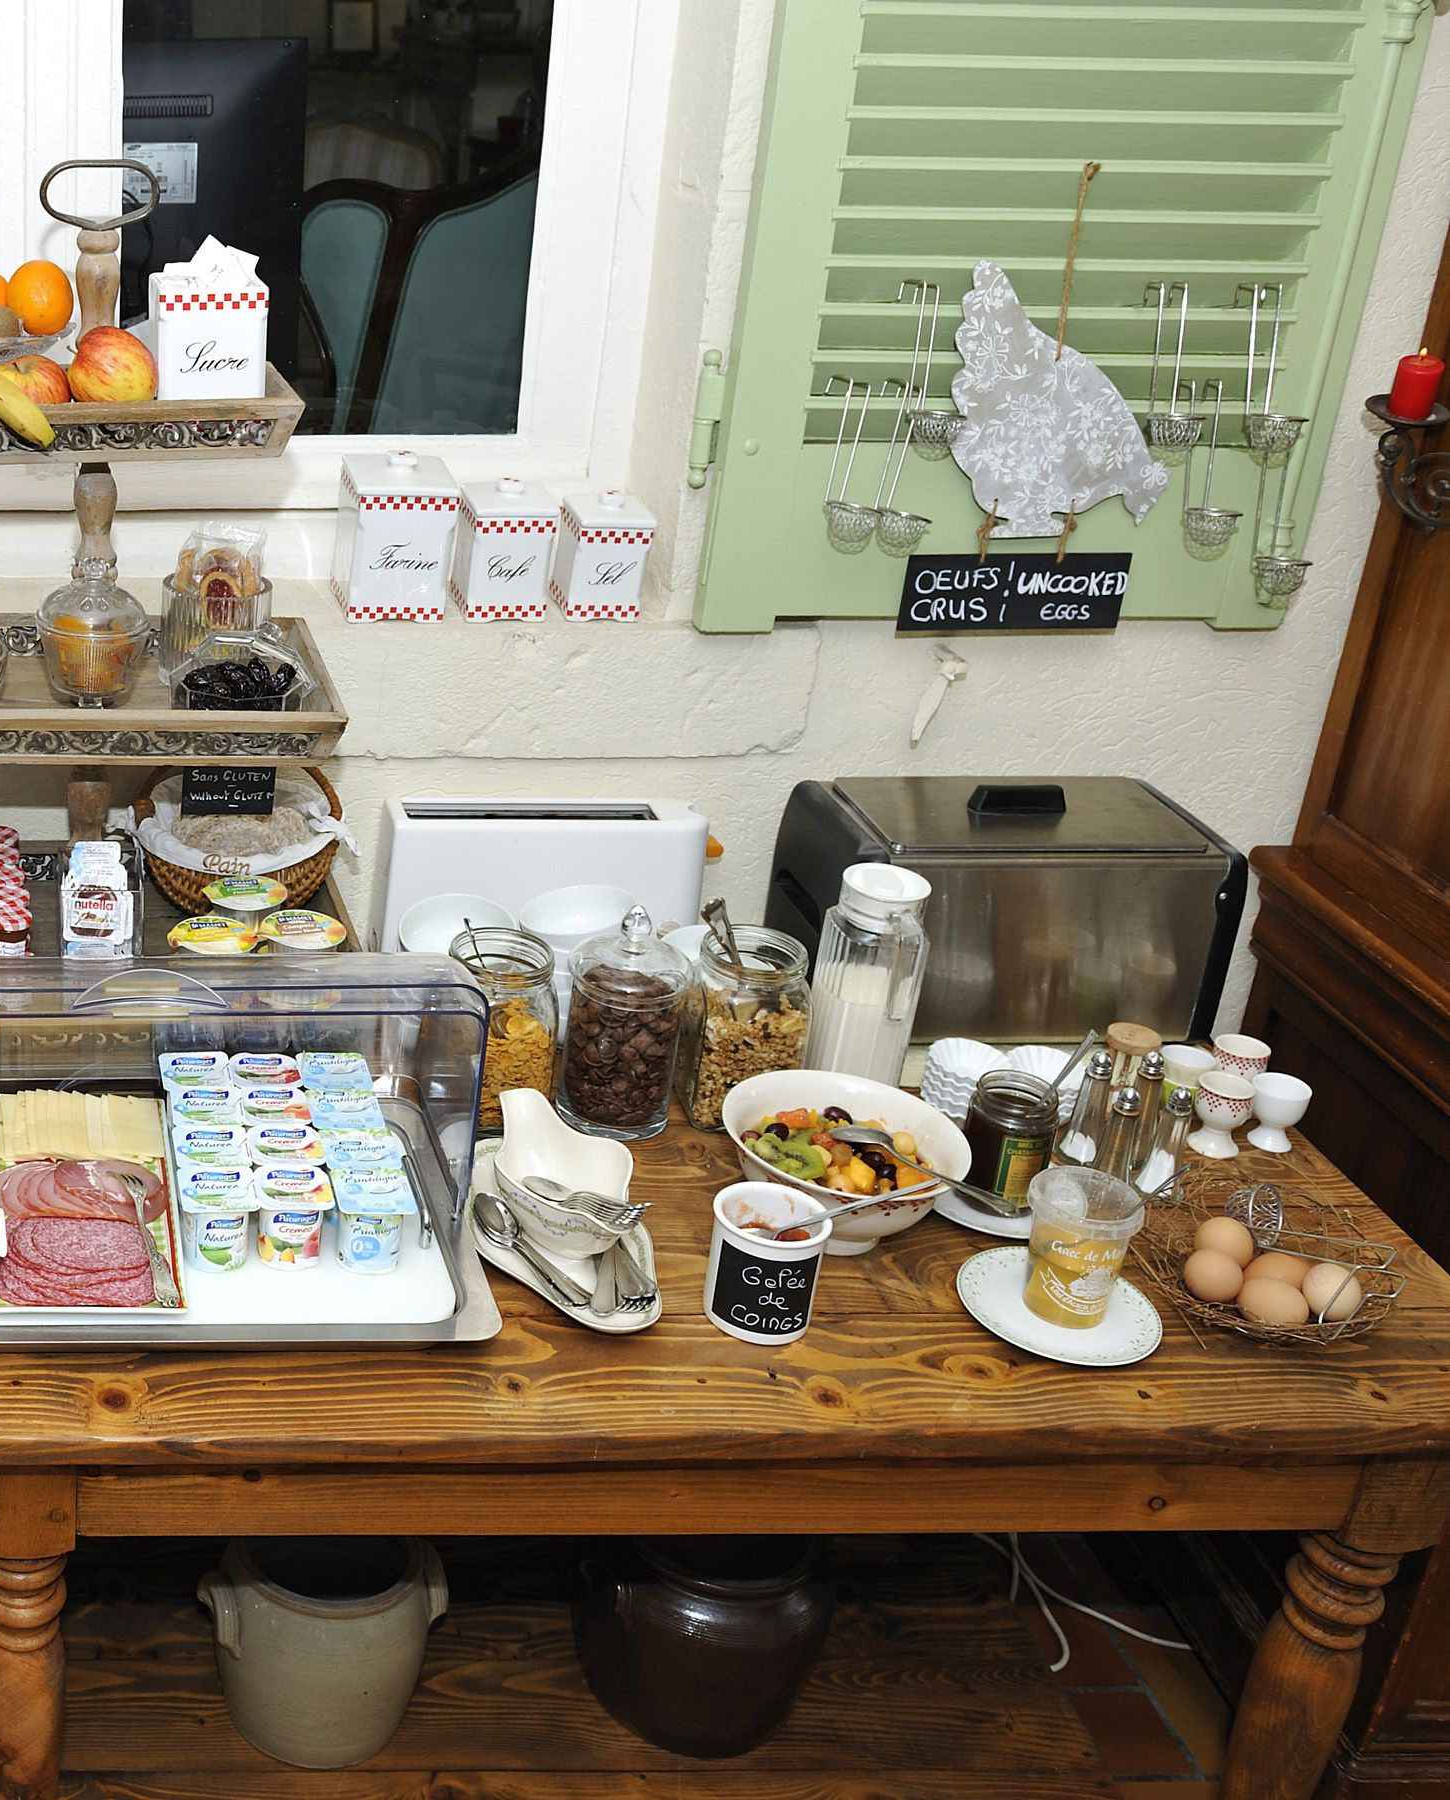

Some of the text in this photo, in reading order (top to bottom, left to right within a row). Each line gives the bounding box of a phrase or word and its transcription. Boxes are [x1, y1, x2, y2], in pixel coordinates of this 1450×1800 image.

[179, 340, 249, 374] Sucre
[369, 542, 439, 571] Farine
[487, 554, 537, 583] Café
[588, 561, 638, 586] Sel
[915, 566, 1001, 595] OEUFS
[1017, 570, 1129, 597] UNCOOKED
[910, 597, 1091, 623] CRUS EGGS
[223, 770, 271, 782] GLUTEN
[202, 853, 251, 876] Pain
[74, 899, 114, 911] nutella
[204, 1232, 244, 1243] Naturea
[278, 1225, 313, 1234] Cremeo
[1051, 1240, 1082, 1258] Gaec
[1084, 1250, 1099, 1262] de
[742, 1265, 807, 1289] Gelée
[758, 1292, 789, 1310] de
